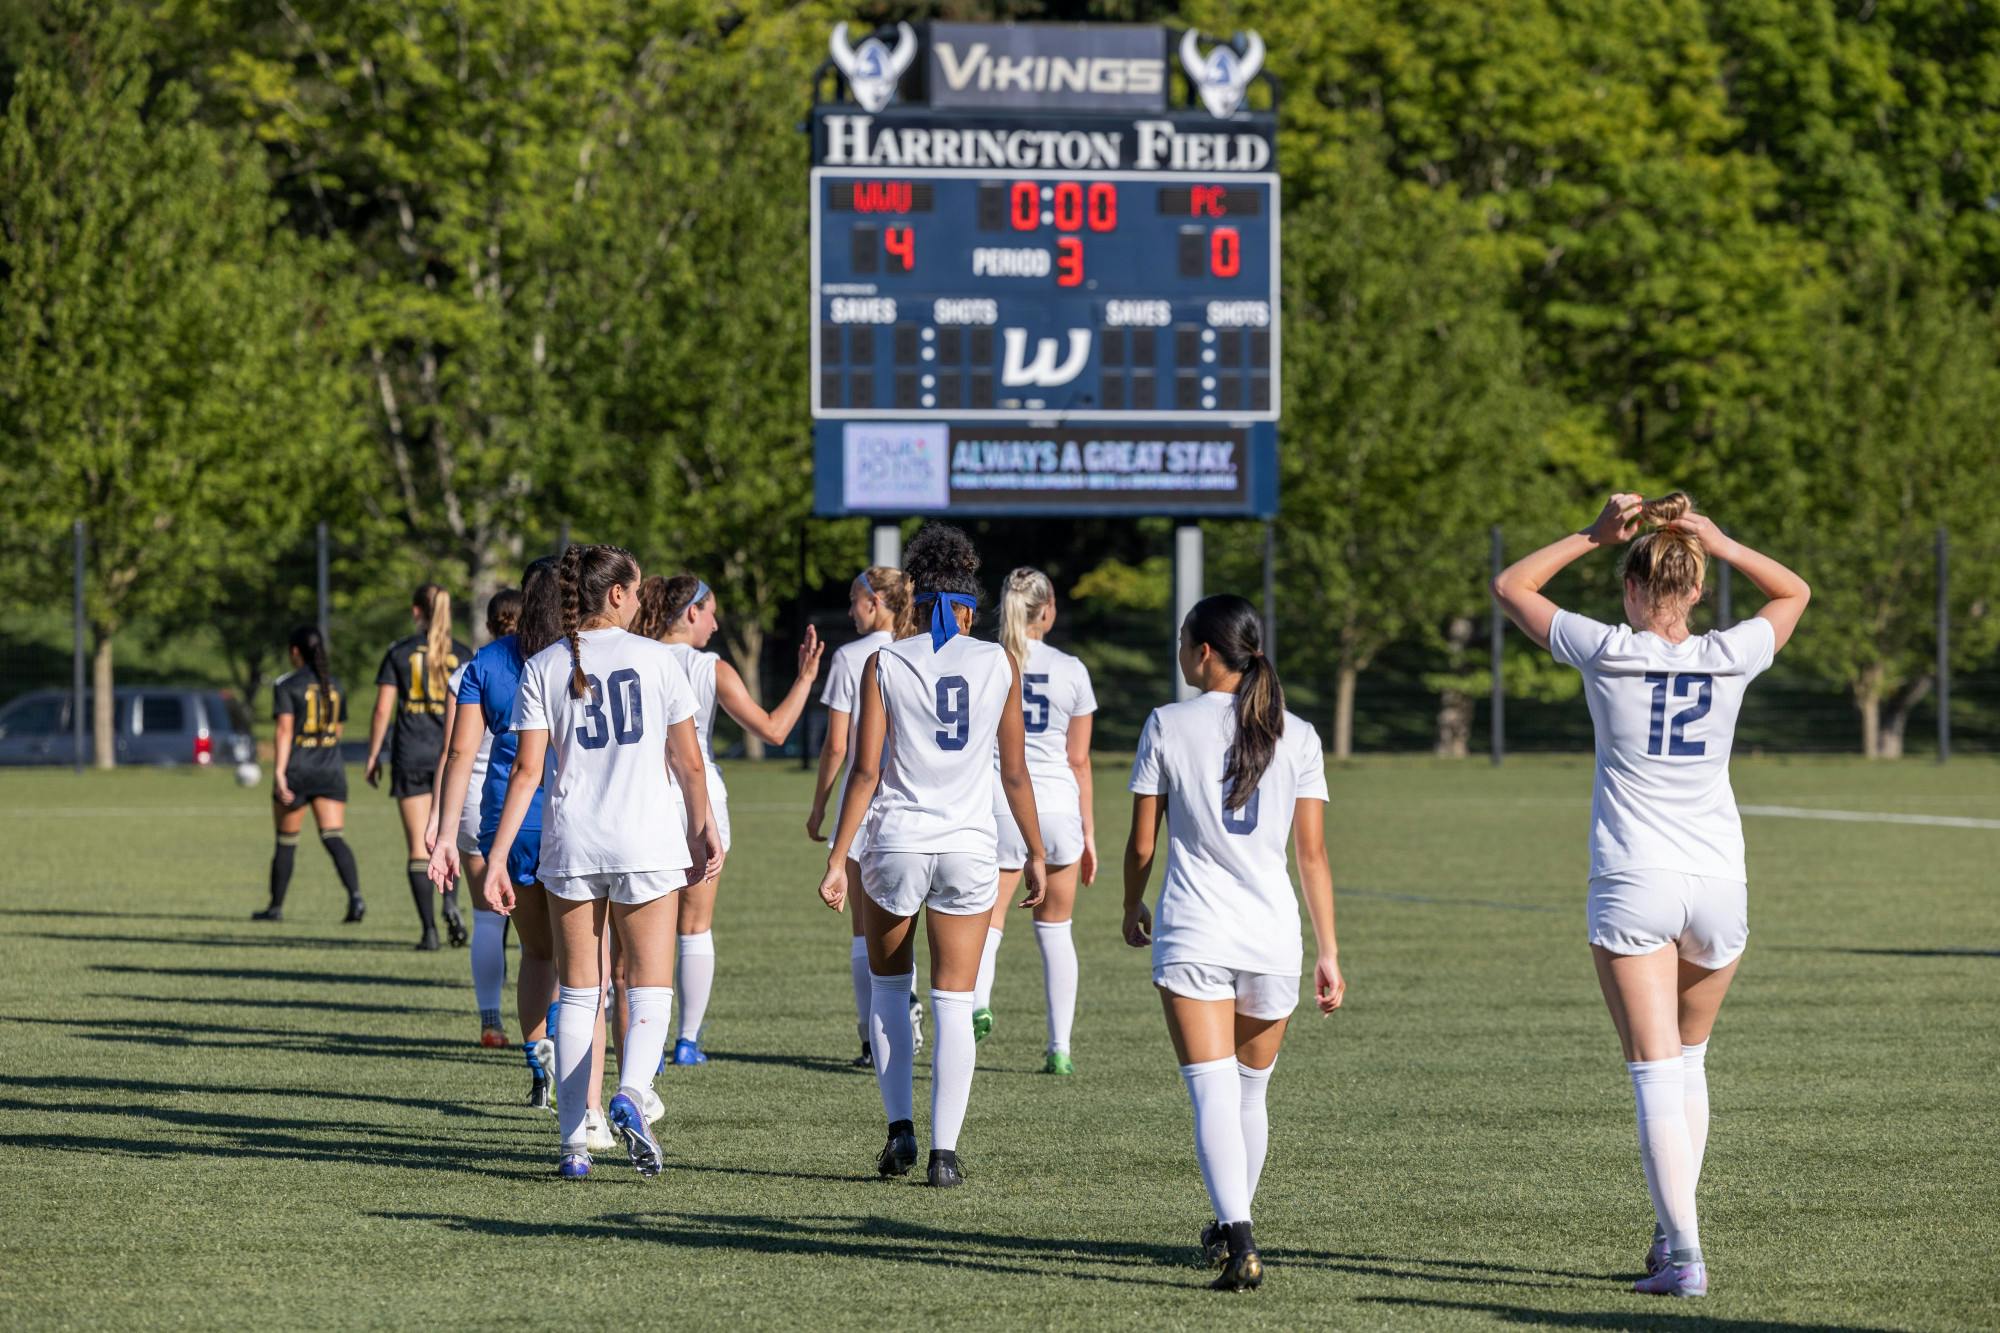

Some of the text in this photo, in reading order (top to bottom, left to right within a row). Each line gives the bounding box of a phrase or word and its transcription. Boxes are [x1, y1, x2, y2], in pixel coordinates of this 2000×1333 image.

[933, 42, 1165, 94] VIKINGS
[823, 115, 1271, 171] HARRINGTON FIELD
[853, 182, 912, 212] WWU
[1011, 181, 1118, 232] 0:00
[1190, 186, 1227, 217] PC
[885, 226, 914, 271] 4
[973, 248, 1051, 277] PERIOD
[1056, 237, 1084, 287] 3
[1211, 228, 1240, 278] 0
[831, 297, 897, 324] SAVES
[934, 299, 998, 325] SHOTS
[1106, 300, 1171, 326] SAVES
[1207, 301, 1269, 327] SHOTS
[952, 440, 1058, 473] ALWAYS
[1060, 440, 1082, 472] A
[1084, 440, 1166, 473] GREAT
[571, 667, 644, 750] 30
[935, 676, 970, 751] 9
[1645, 672, 1713, 756] 12
